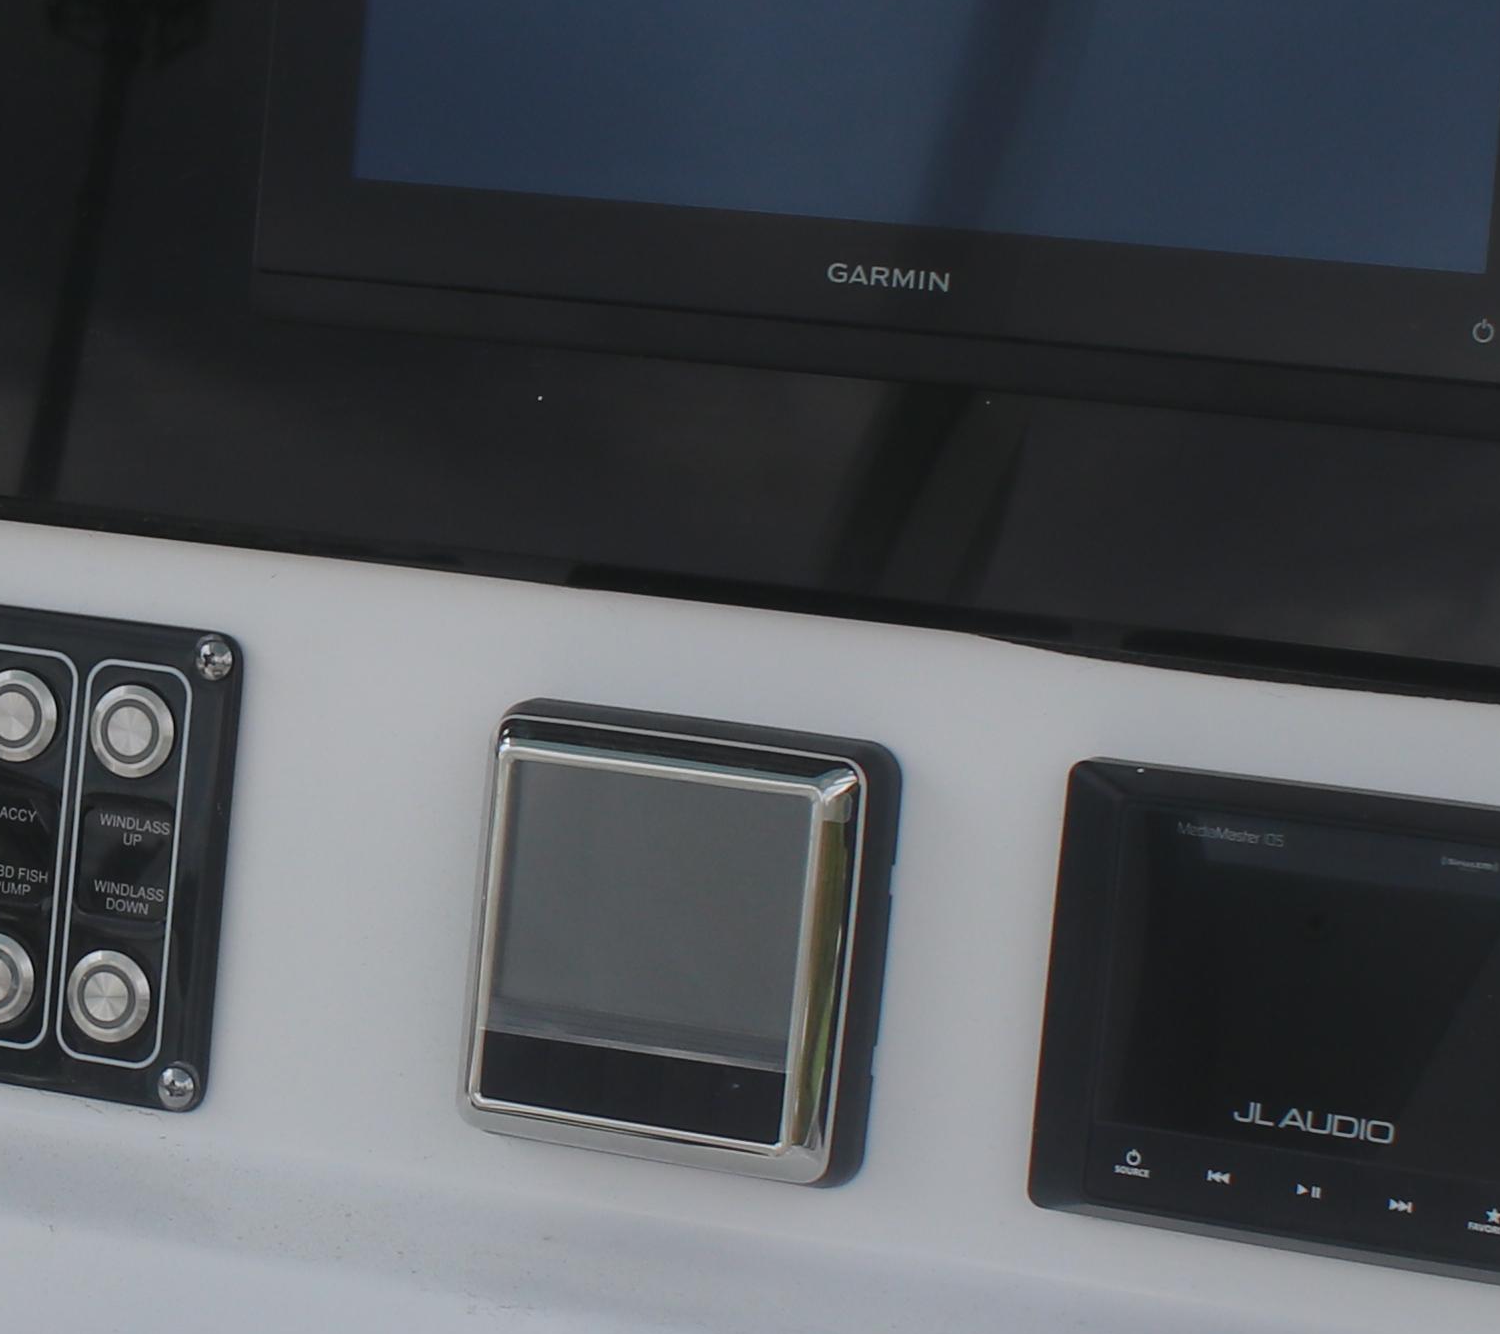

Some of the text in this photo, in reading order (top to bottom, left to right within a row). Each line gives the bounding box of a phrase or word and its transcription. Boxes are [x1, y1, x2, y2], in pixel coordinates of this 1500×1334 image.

[827, 262, 950, 293] GARMIN
[99, 813, 170, 835] WINDLASS
[122, 831, 142, 846] UP
[17, 866, 48, 883] FISH
[93, 879, 164, 902] WINDLASS
[105, 896, 149, 915] DOWN
[1233, 1102, 1395, 1145] JL AUDIO
[1114, 1164, 1150, 1179] SOURCE
